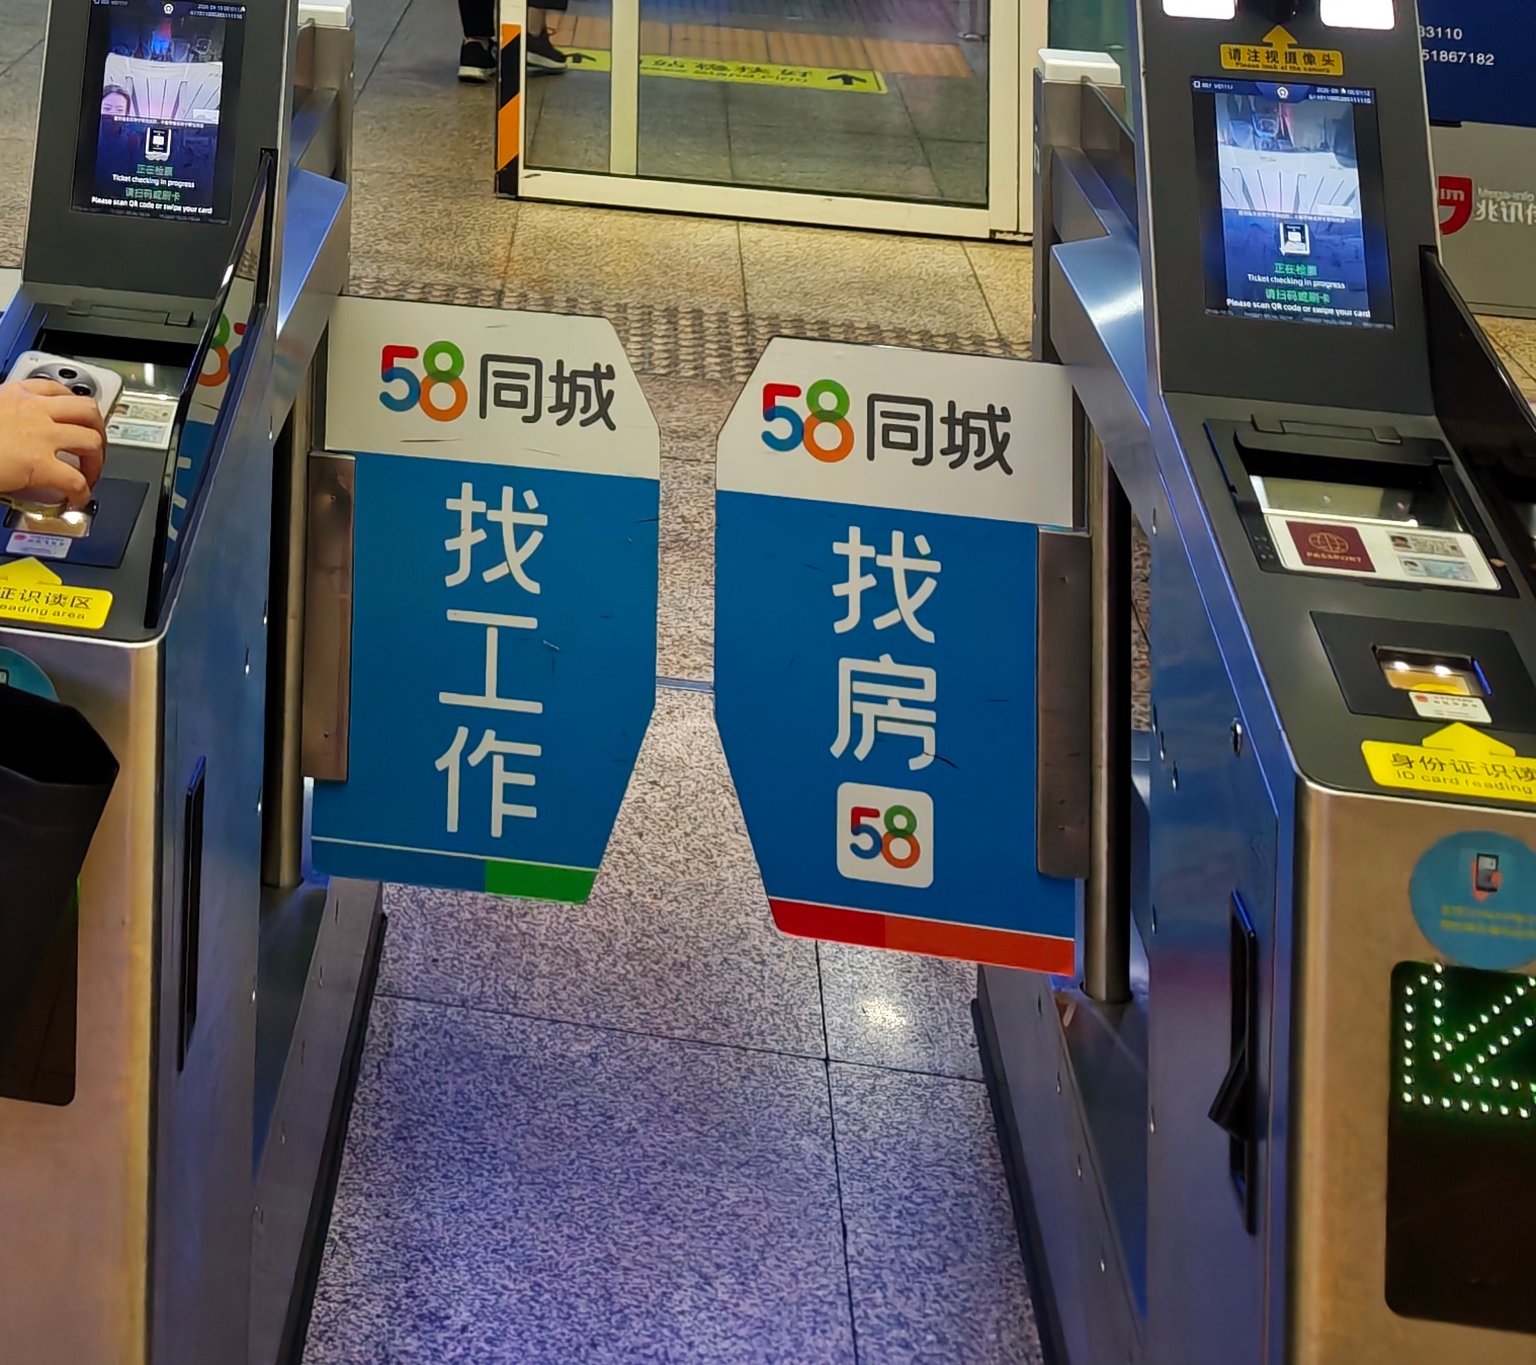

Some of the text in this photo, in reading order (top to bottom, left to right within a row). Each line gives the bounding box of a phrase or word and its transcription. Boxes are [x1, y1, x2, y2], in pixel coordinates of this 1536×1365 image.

[1228, 47, 1335, 67] 请注视摄像头
[379, 340, 617, 431] 58同城
[761, 378, 1014, 476] 58同城
[1306, 551, 1362, 564] PASSPORT
[52, 610, 85, 621] area
[830, 525, 942, 773] 找房
[435, 481, 549, 839] 找工作
[1397, 769, 1533, 796] ID card reading
[848, 803, 921, 870] 58
